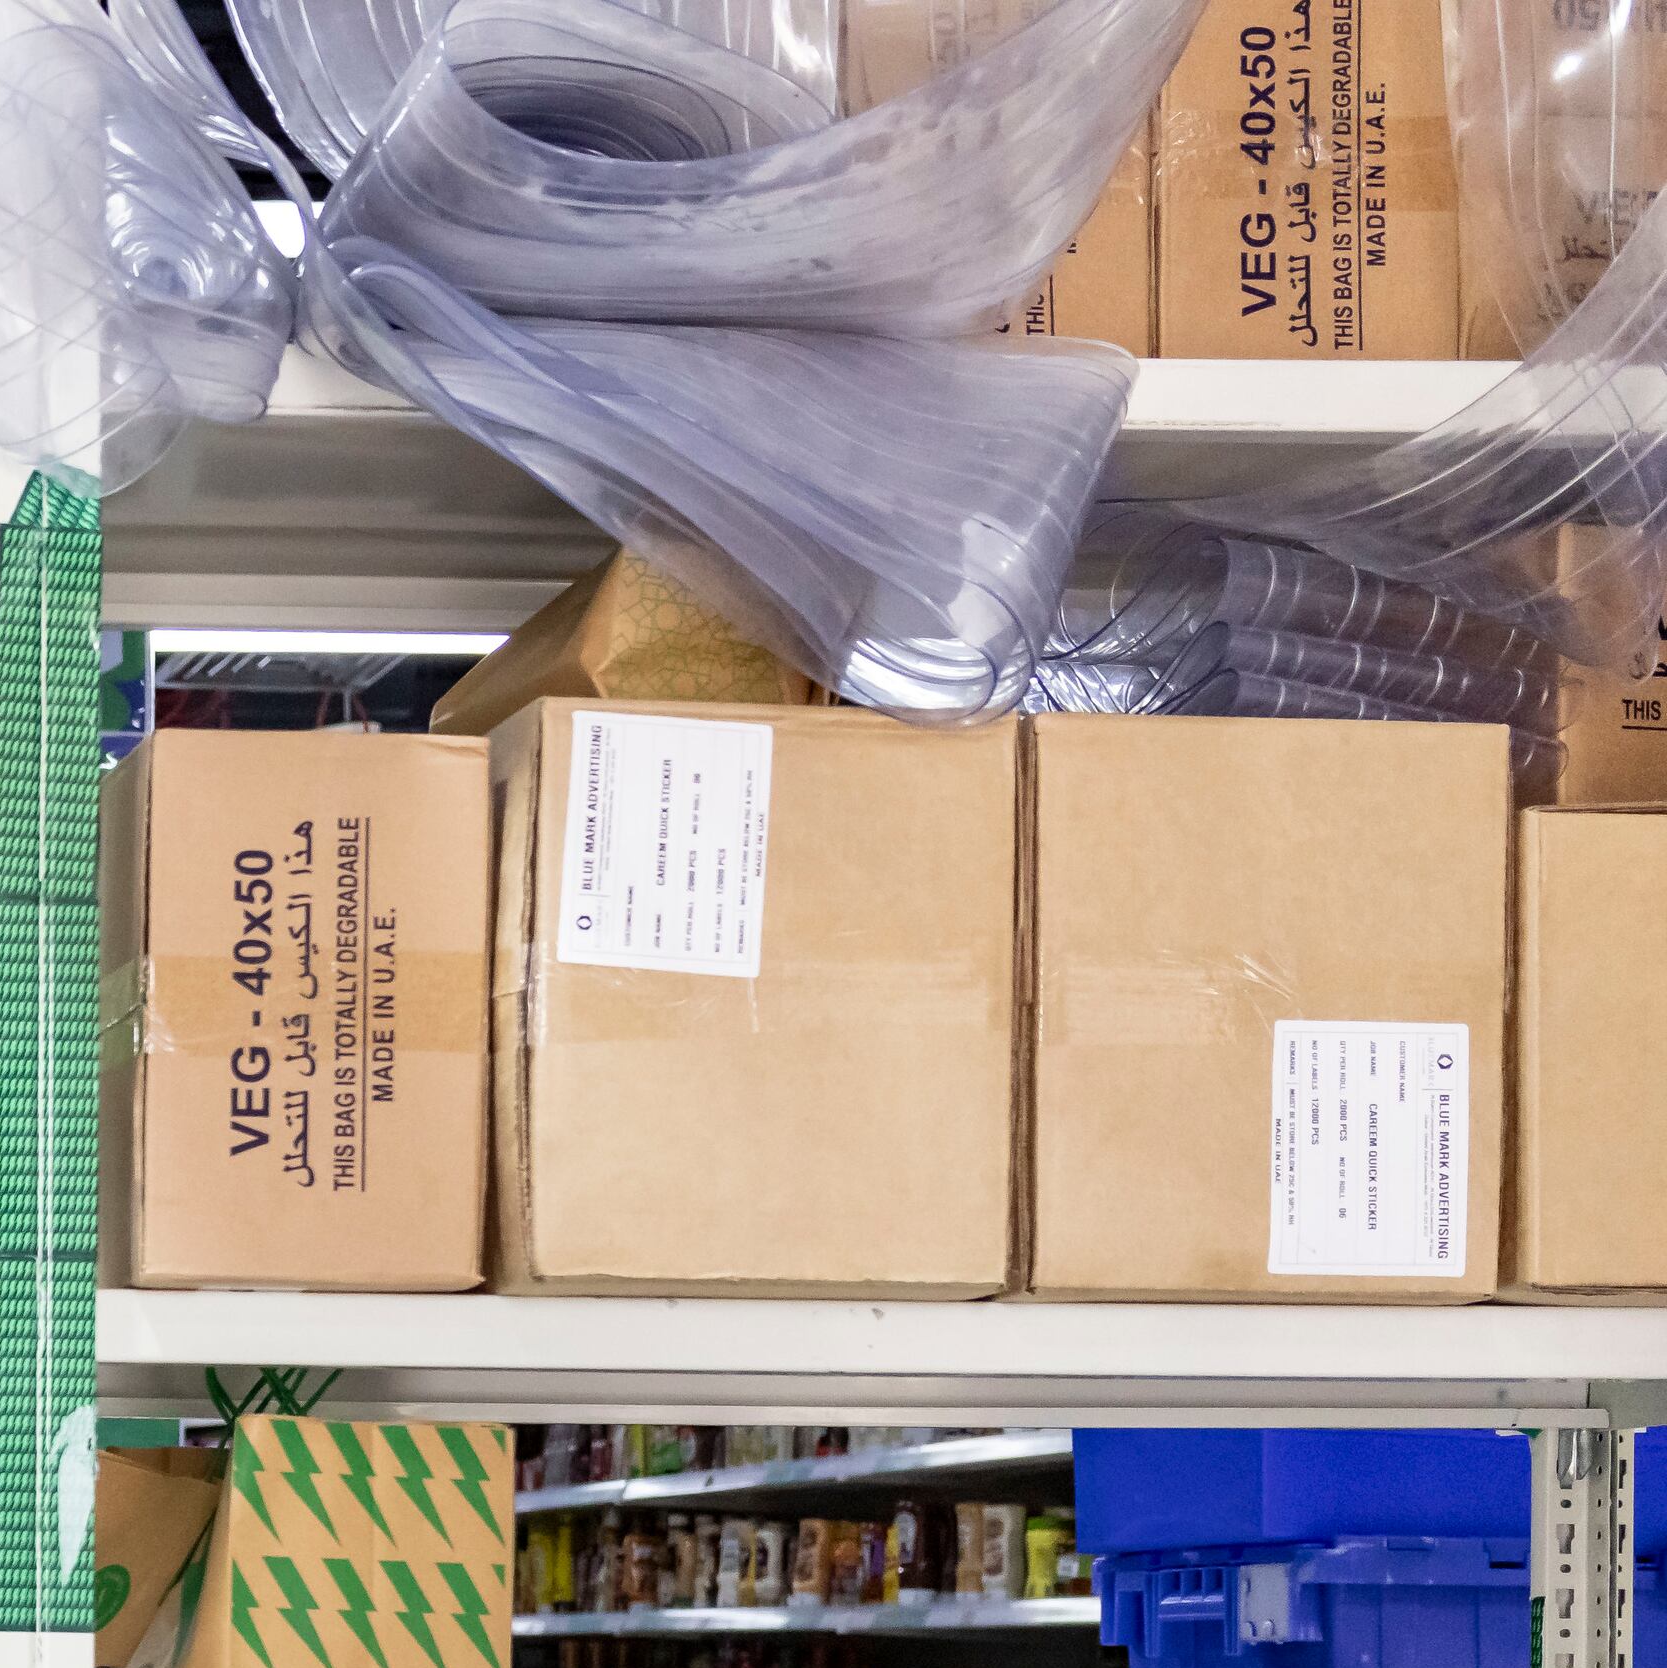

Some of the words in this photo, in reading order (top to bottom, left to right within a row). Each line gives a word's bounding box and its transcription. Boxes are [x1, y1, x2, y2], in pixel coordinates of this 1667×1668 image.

[1332, 0, 1353, 139] DEGRADABLE
[1240, 26, 1277, 166] 40x50
[1366, 82, 1386, 158] U.A.E.
[1332, 142, 1352, 228] TOTALLY
[1366, 164, 1386, 191] IN
[1285, 181, 1317, 243] قابل
[1366, 197, 1386, 267] MADE
[1333, 232, 1353, 252] IS
[1240, 213, 1277, 317] VEG
[1333, 256, 1353, 301] BAG
[1288, 254, 1318, 348] للتحلل
[1334, 306, 1354, 350] THIS
[1622, 698, 1662, 722] THIS
[587, 724, 602, 811] ADVERTISING
[660, 759, 672, 803] STICKER
[283, 820, 314, 875] هذا
[585, 816, 597, 853] MARK
[582, 858, 594, 890] BLUE
[656, 843, 667, 886] CAREEM
[336, 815, 361, 966] DEGRADABLE
[232, 849, 274, 996] 40x50
[287, 892, 318, 1000] الكيس
[373, 907, 398, 987] U.A.E.
[335, 966, 359, 1062] TOTALLY
[373, 993, 395, 1022] IN
[282, 1013, 315, 1077] قابل
[371, 1030, 395, 1103] MADE
[336, 1066, 356, 1087] IS
[229, 1044, 272, 1156] VEG
[335, 1095, 356, 1142] BAG
[1311, 1098, 1319, 1124] 12000
[1339, 1099, 1347, 1121] 2000
[1439, 1094, 1450, 1128] BLUE
[281, 1089, 314, 1188] للتحلل
[1311, 1127, 1319, 1145] PCS
[1339, 1124, 1347, 1142] PCS
[1368, 1103, 1378, 1147] CAREEM
[333, 1148, 355, 1193] THIS
[1275, 1151, 1282, 1161] IN
[1368, 1150, 1378, 1182] QUICK
[1438, 1131, 1450, 1169] MARK
[1338, 1208, 1346, 1219] 06
[1368, 1186, 1377, 1231] STICKER
[1437, 1173, 1450, 1259] ADVERTISING
